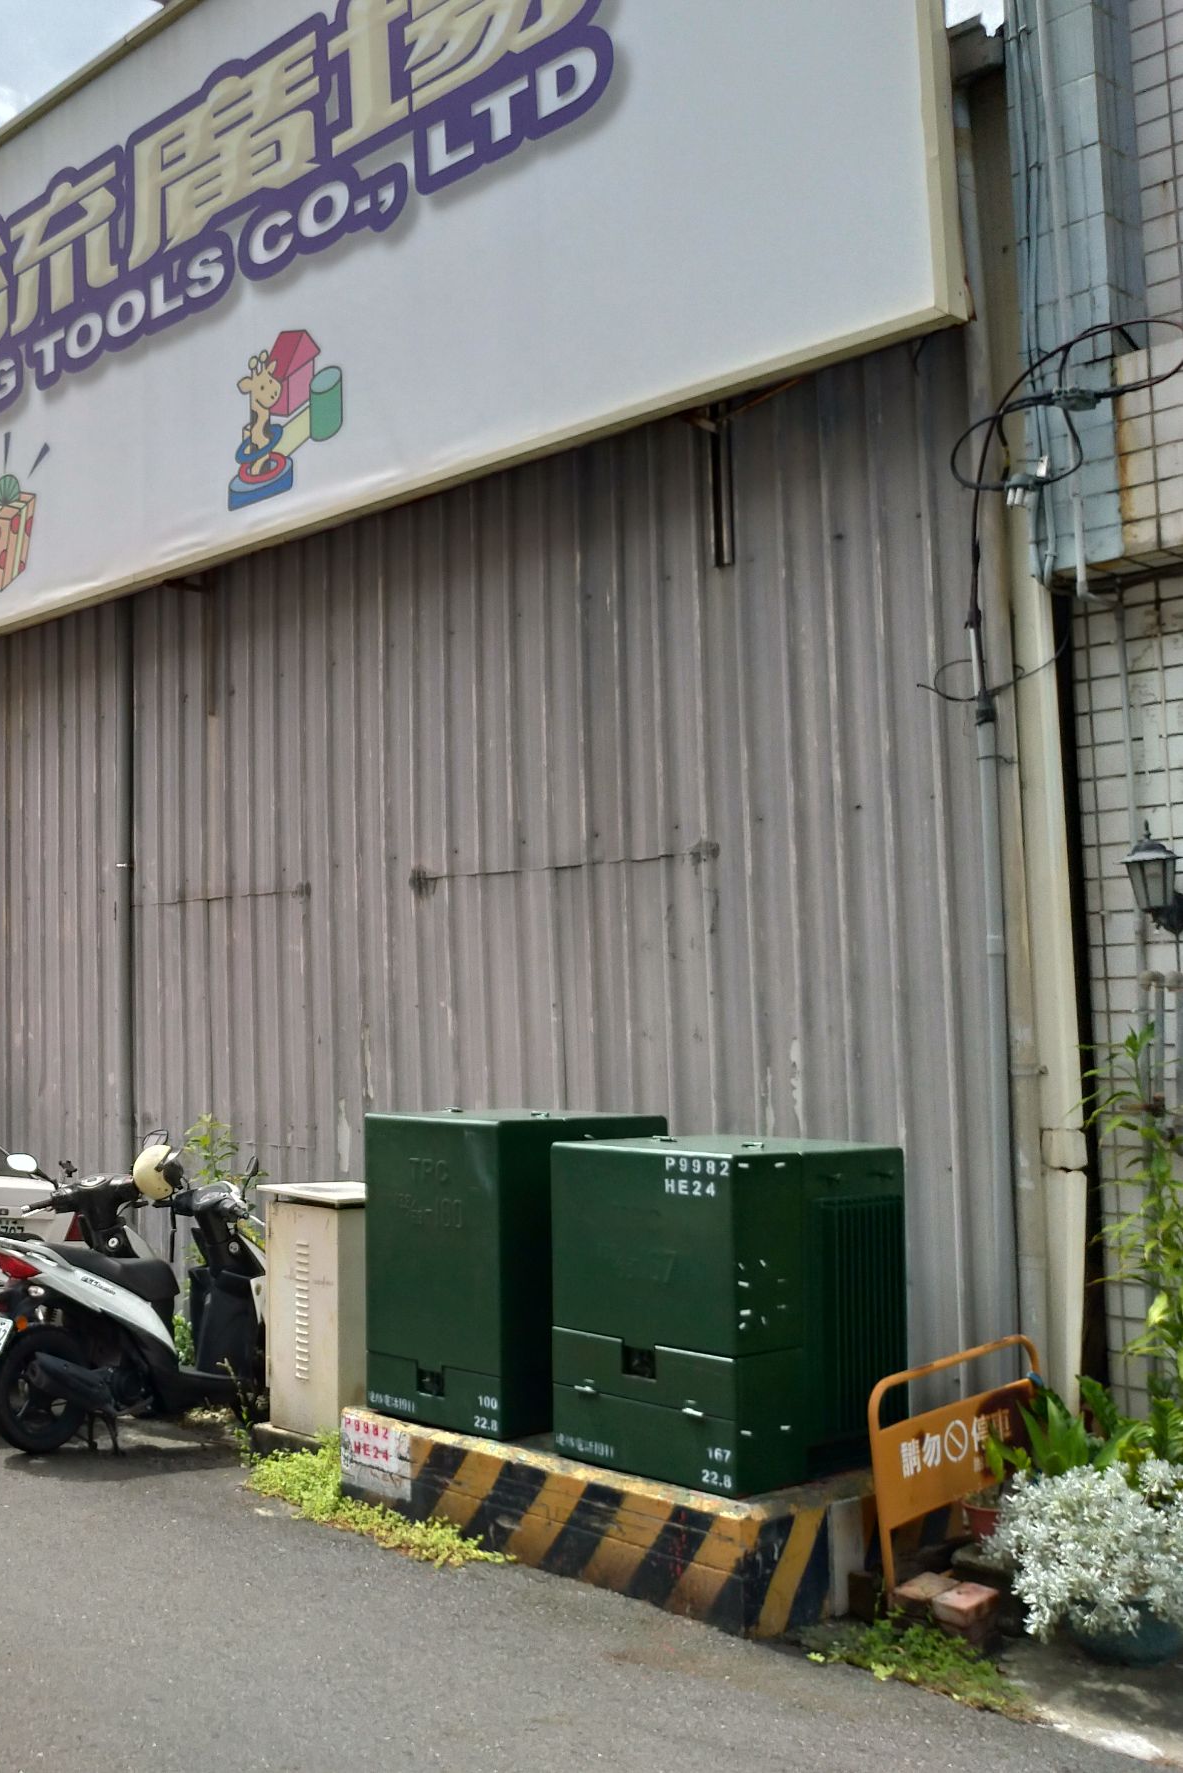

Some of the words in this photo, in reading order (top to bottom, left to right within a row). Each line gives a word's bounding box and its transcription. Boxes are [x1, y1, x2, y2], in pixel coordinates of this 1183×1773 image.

[34, 248, 225, 378] TOOLS
[248, 181, 395, 265] CO.,
[426, 47, 597, 176] LTD
[665, 1157, 730, 1176] P9982
[665, 1178, 716, 1197] HE24
[478, 1395, 498, 1410] 100
[474, 1415, 498, 1432] 22.8
[707, 1447, 731, 1462] 167
[701, 1469, 732, 1488] 22.8
